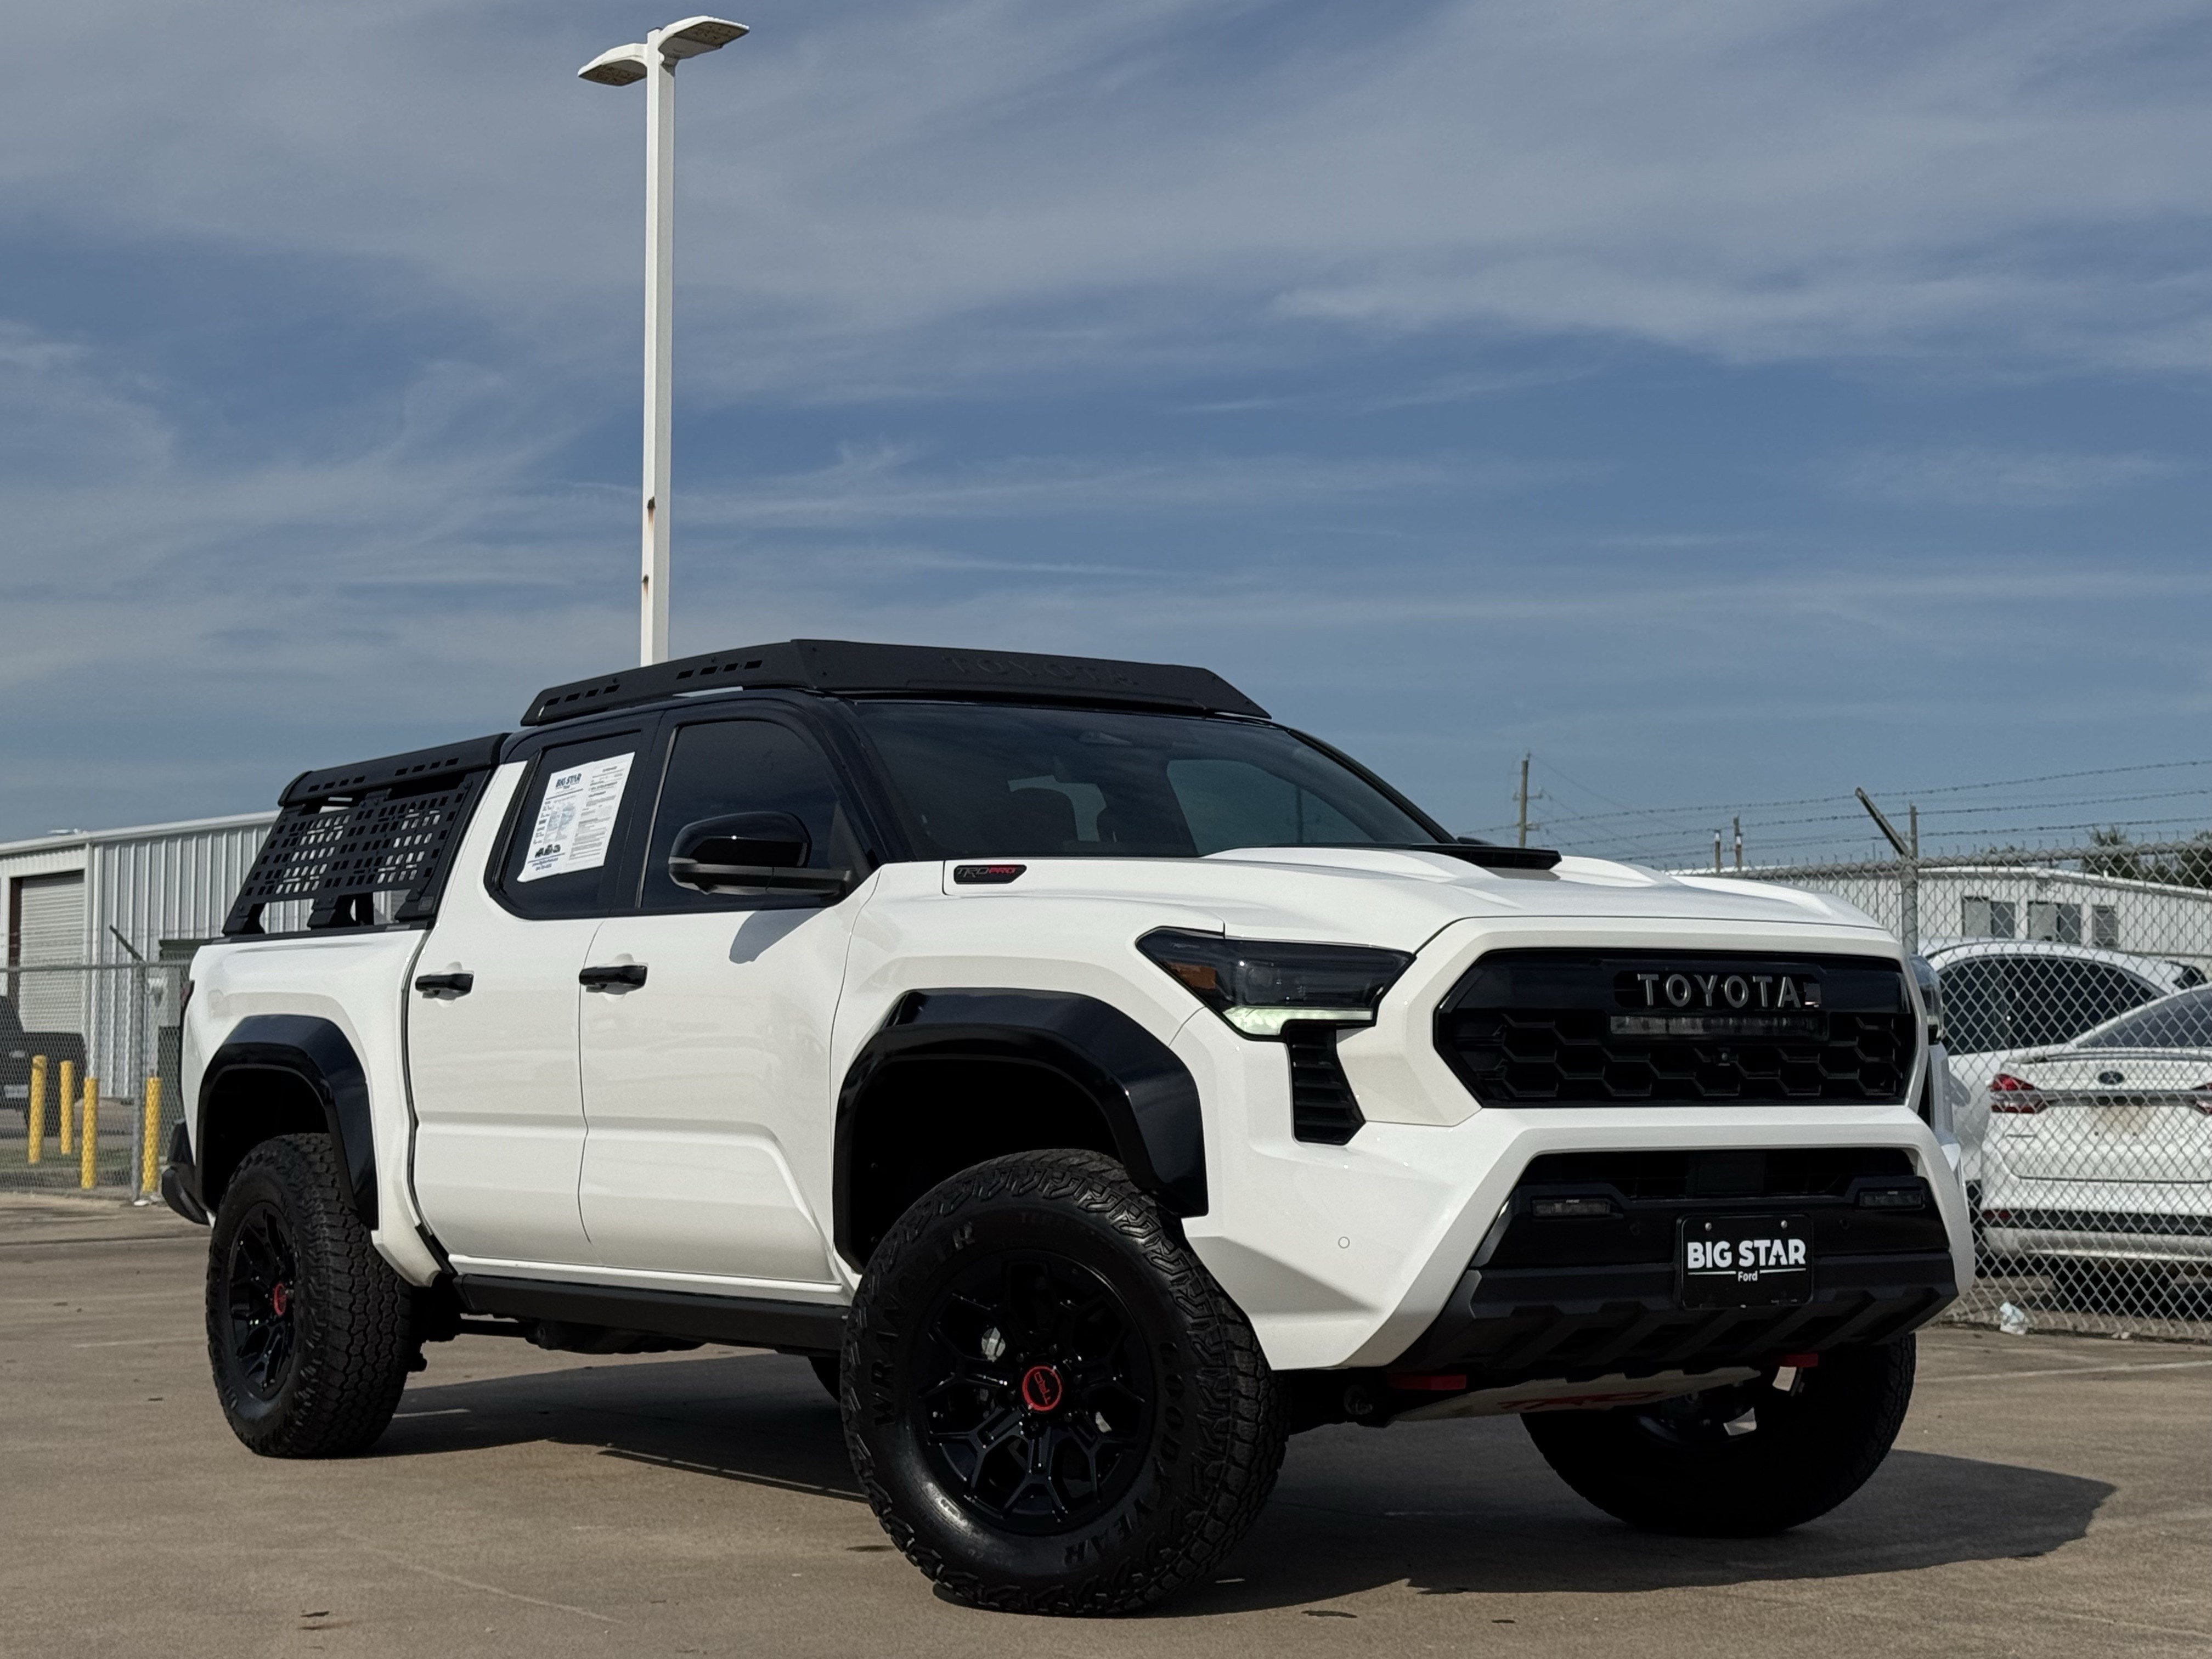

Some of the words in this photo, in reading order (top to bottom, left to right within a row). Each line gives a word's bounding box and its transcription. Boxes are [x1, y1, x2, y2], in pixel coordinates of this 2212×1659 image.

[941, 654, 1139, 686] TOYOTA
[956, 867, 989, 878] TRD
[1637, 973, 1801, 1008] TOYOTA
[1687, 1241, 1733, 1269] BIG
[1739, 1239, 1806, 1268] STAR
[1737, 1270, 1758, 1282] Ford
